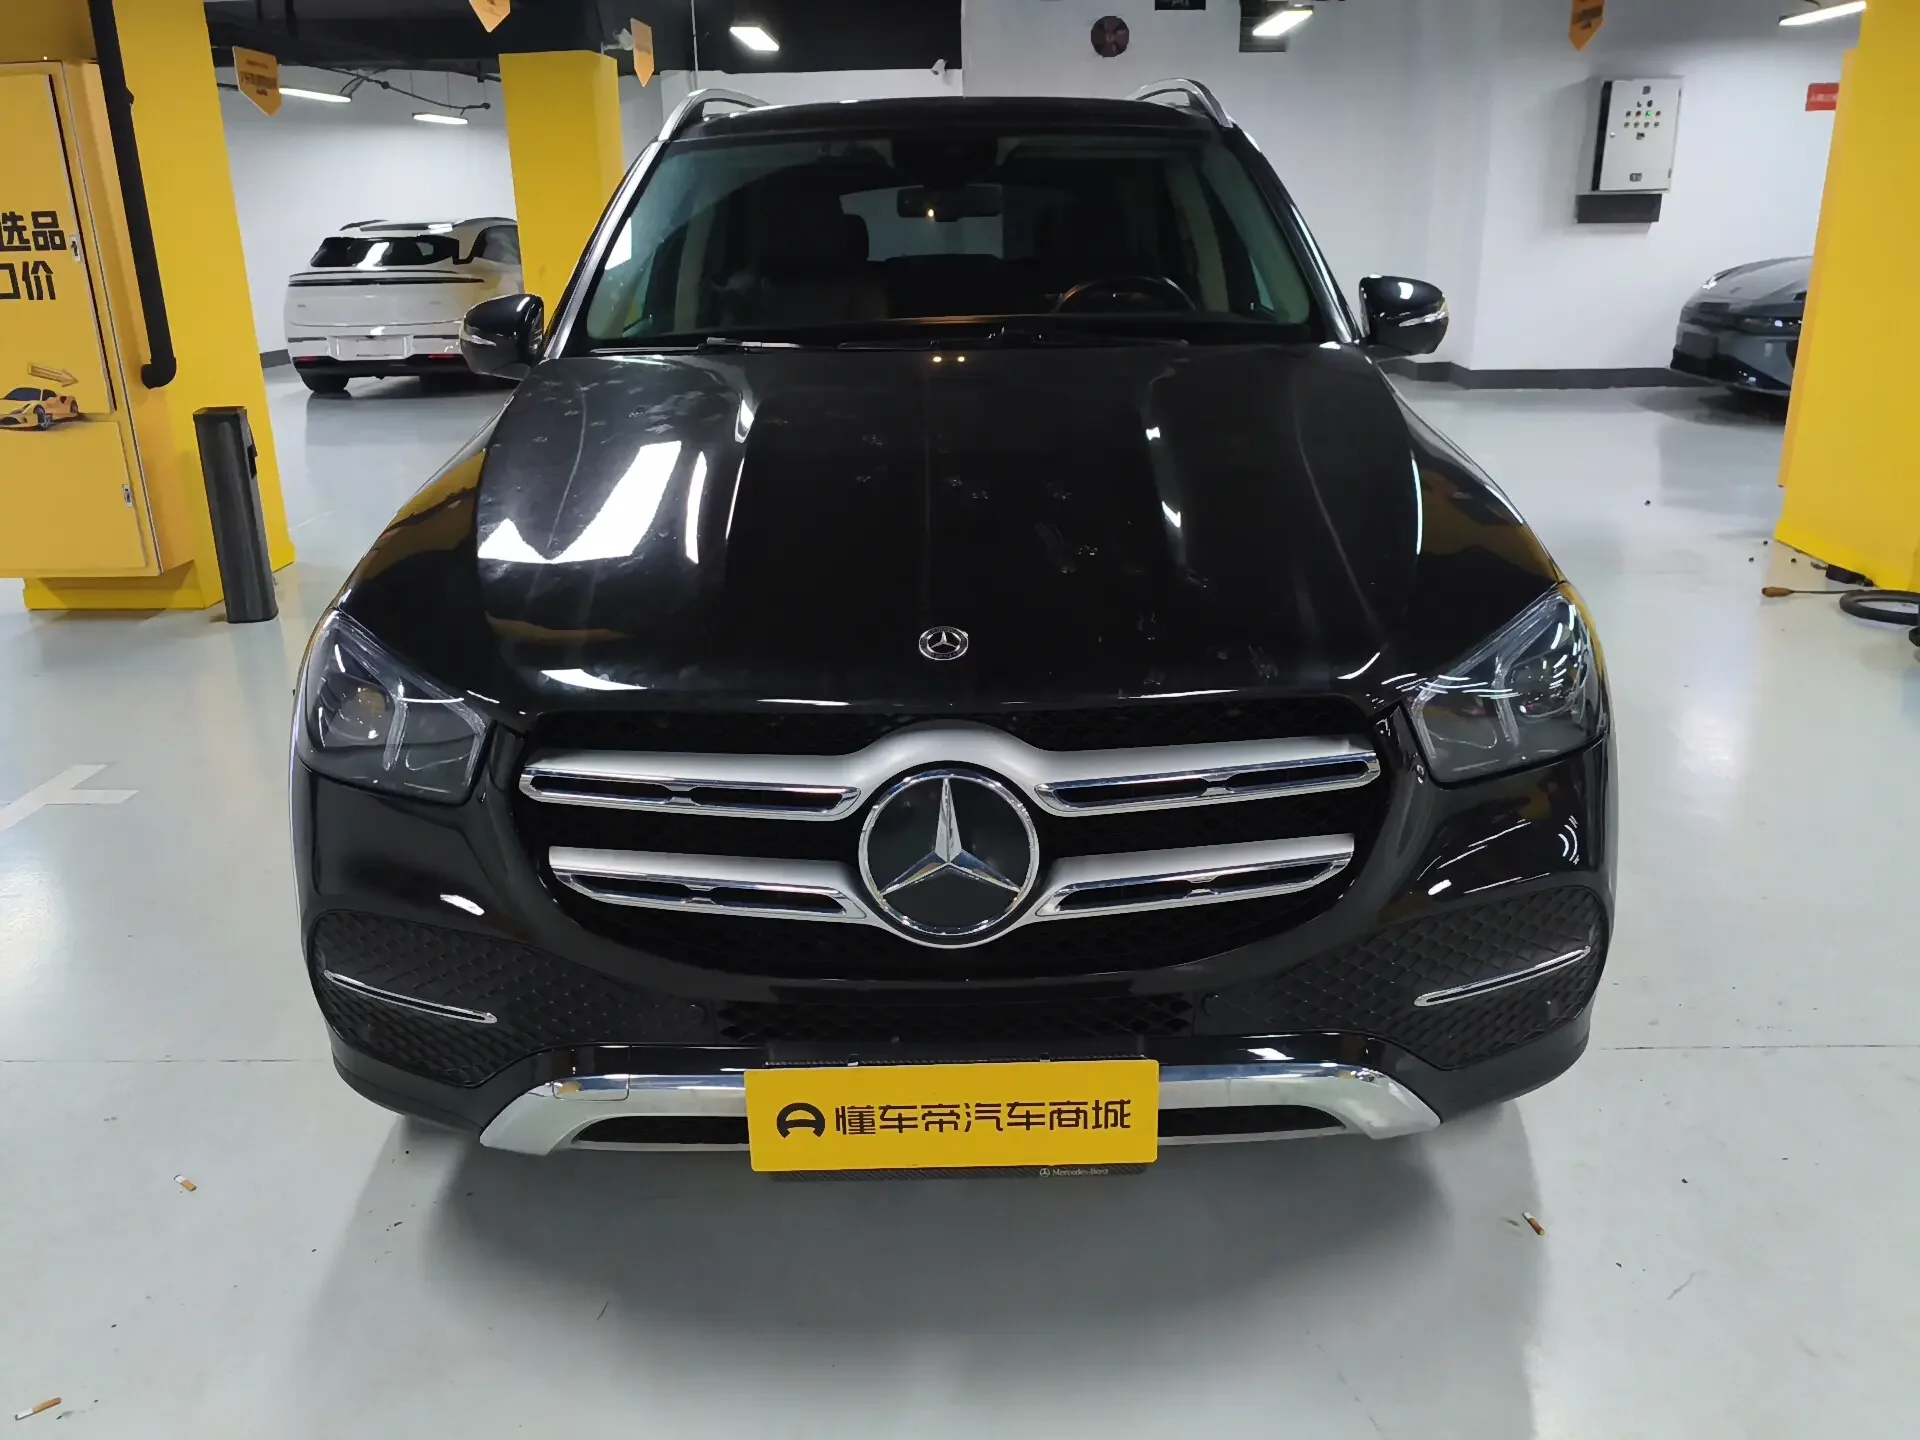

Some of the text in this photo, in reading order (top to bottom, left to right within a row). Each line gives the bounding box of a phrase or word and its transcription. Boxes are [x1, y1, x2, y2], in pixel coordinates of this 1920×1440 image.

[0, 210, 67, 251] 选品
[835, 1099, 1132, 1136] 懂车帝汽车商城
